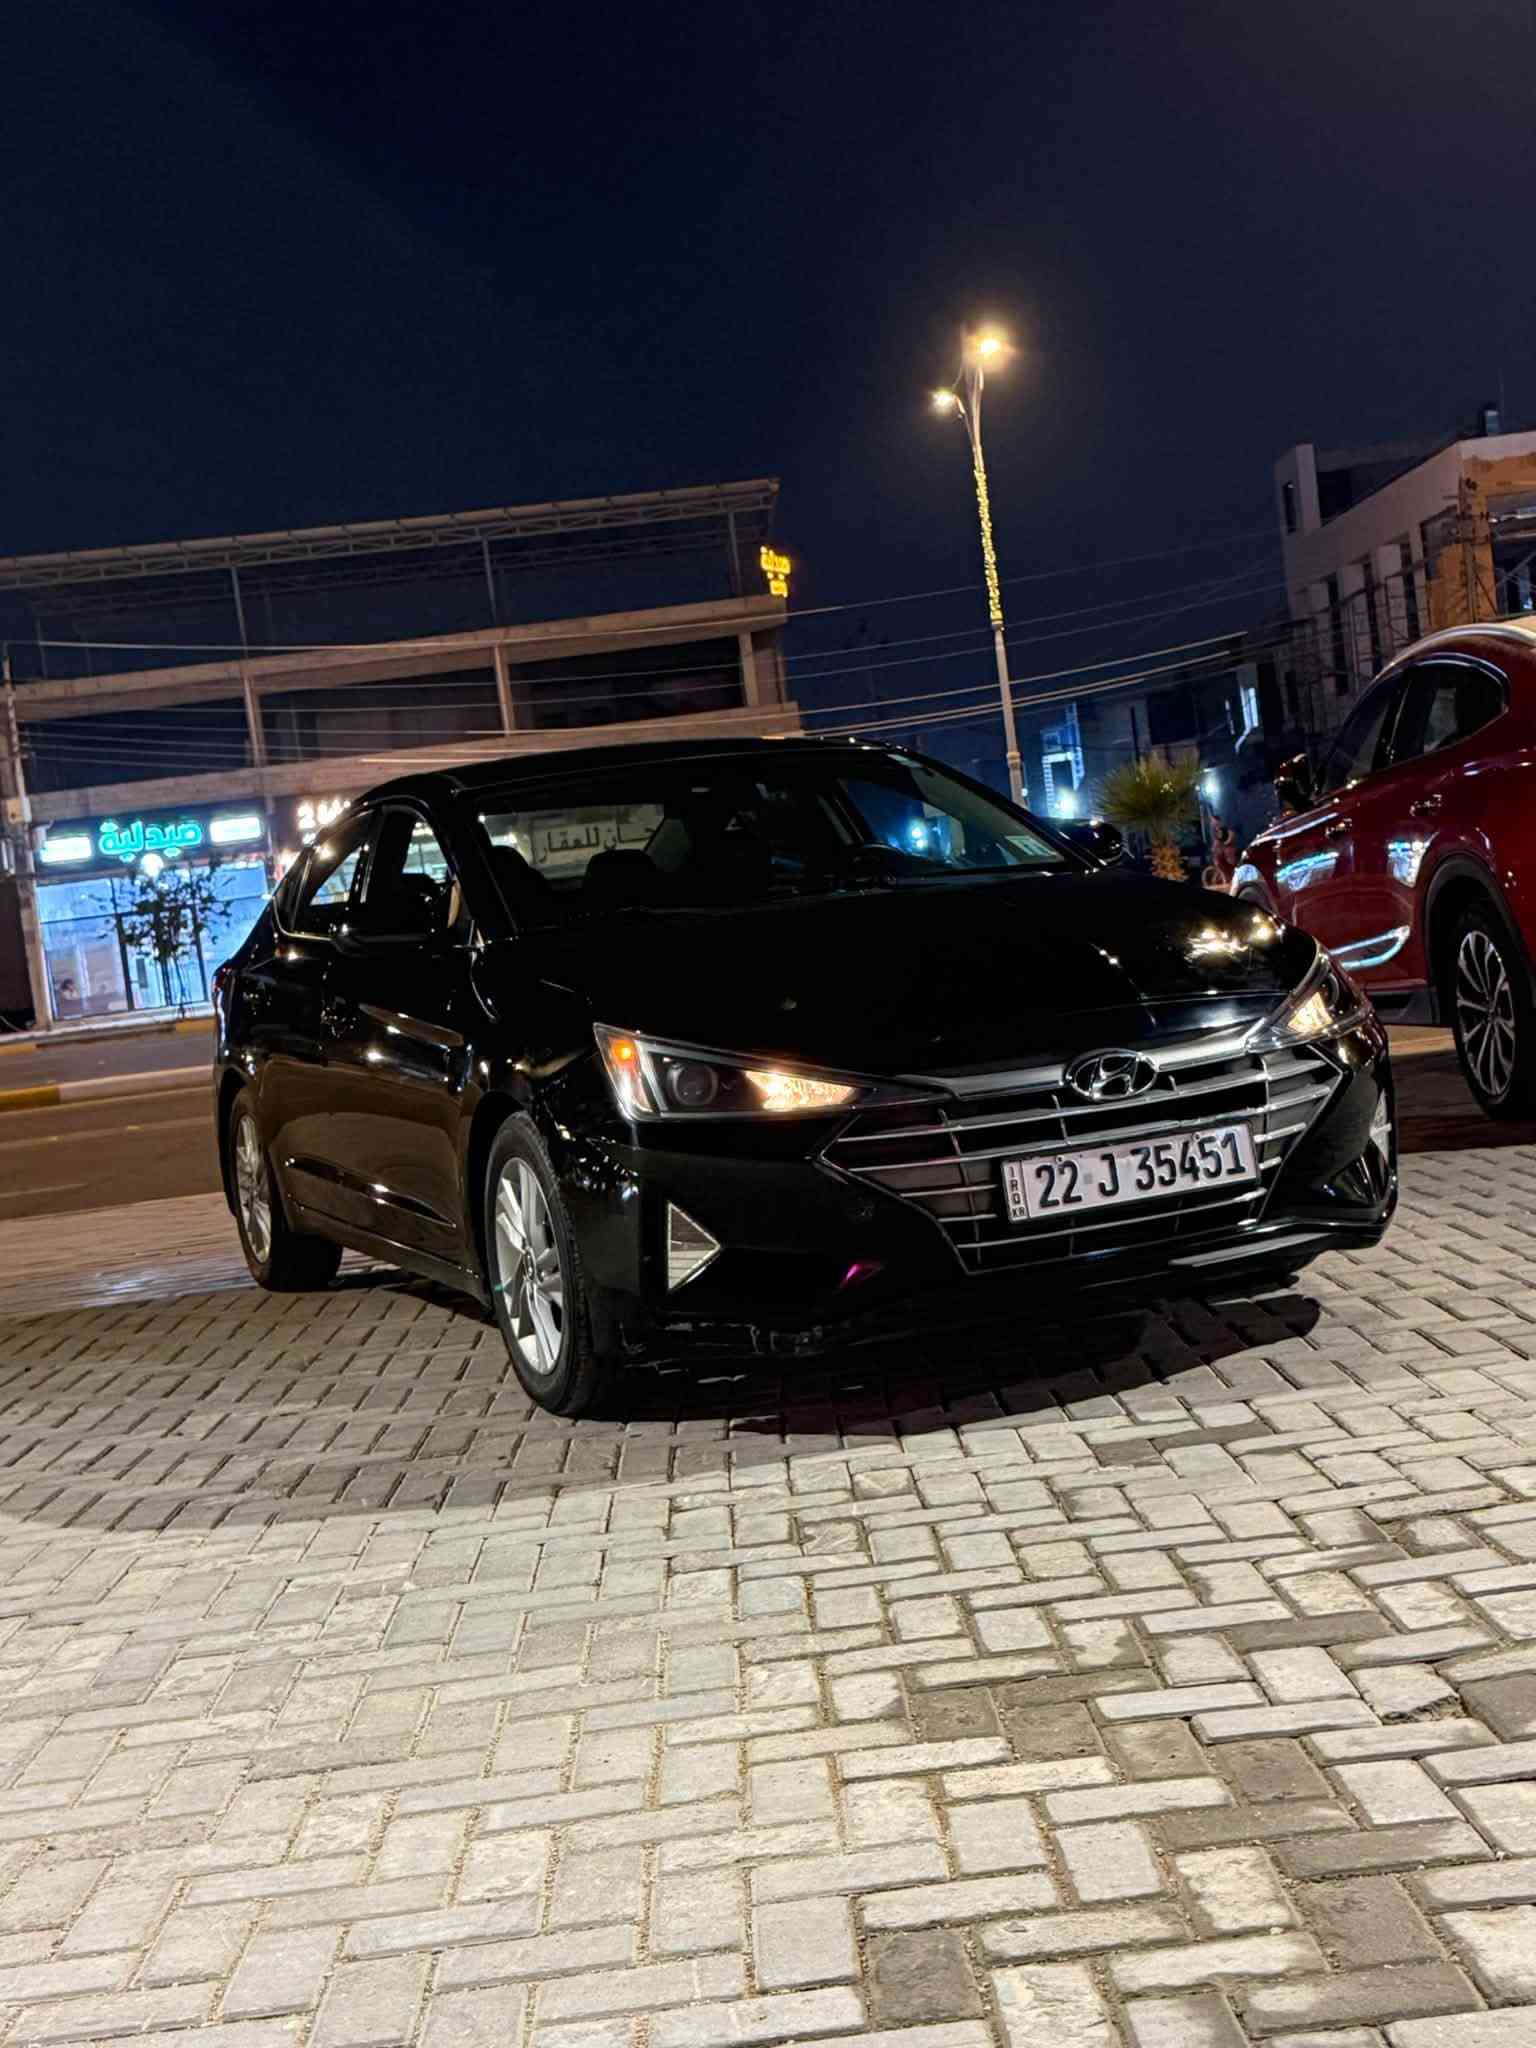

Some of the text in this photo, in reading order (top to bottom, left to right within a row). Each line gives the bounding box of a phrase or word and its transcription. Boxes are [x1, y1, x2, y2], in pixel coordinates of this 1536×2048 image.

[99, 819, 202, 862] صيدلية
[1036, 1132, 1245, 1208] 22 J 35451
